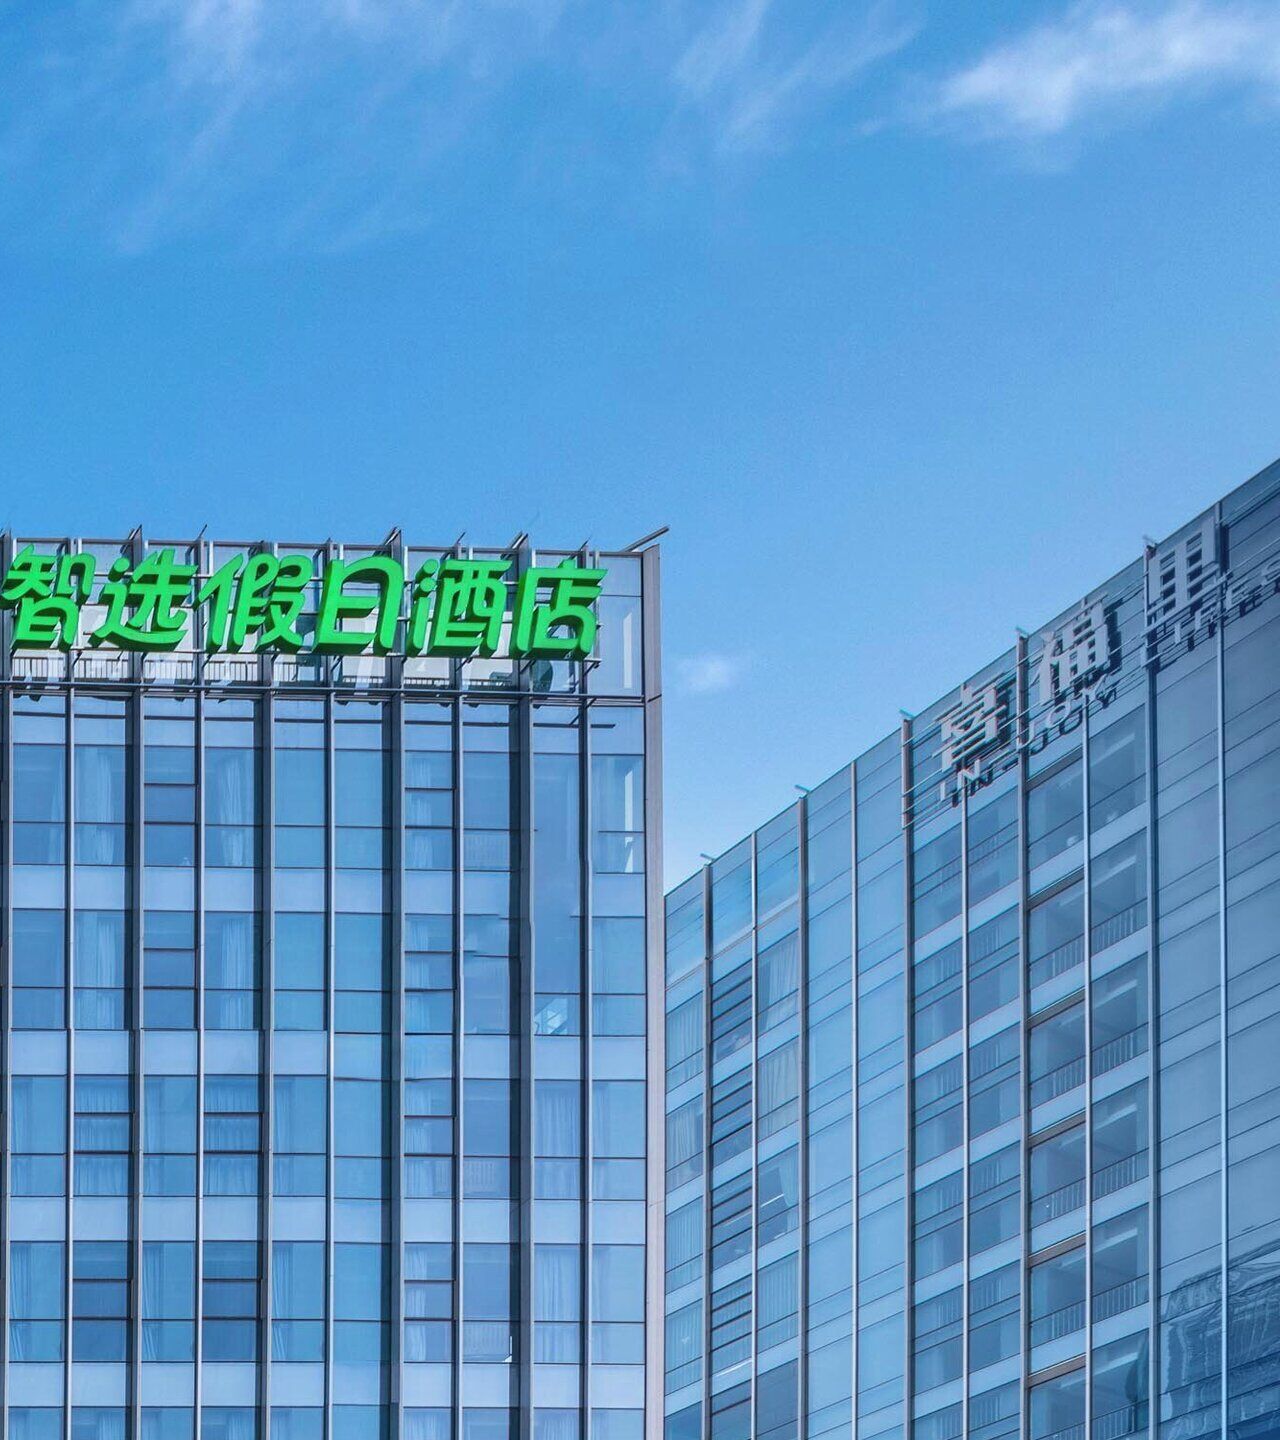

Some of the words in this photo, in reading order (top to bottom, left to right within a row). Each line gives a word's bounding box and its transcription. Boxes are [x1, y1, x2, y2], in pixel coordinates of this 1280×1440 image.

[0, 543, 609, 660] 智选假日酒店
[931, 515, 1233, 772] 喜福里
